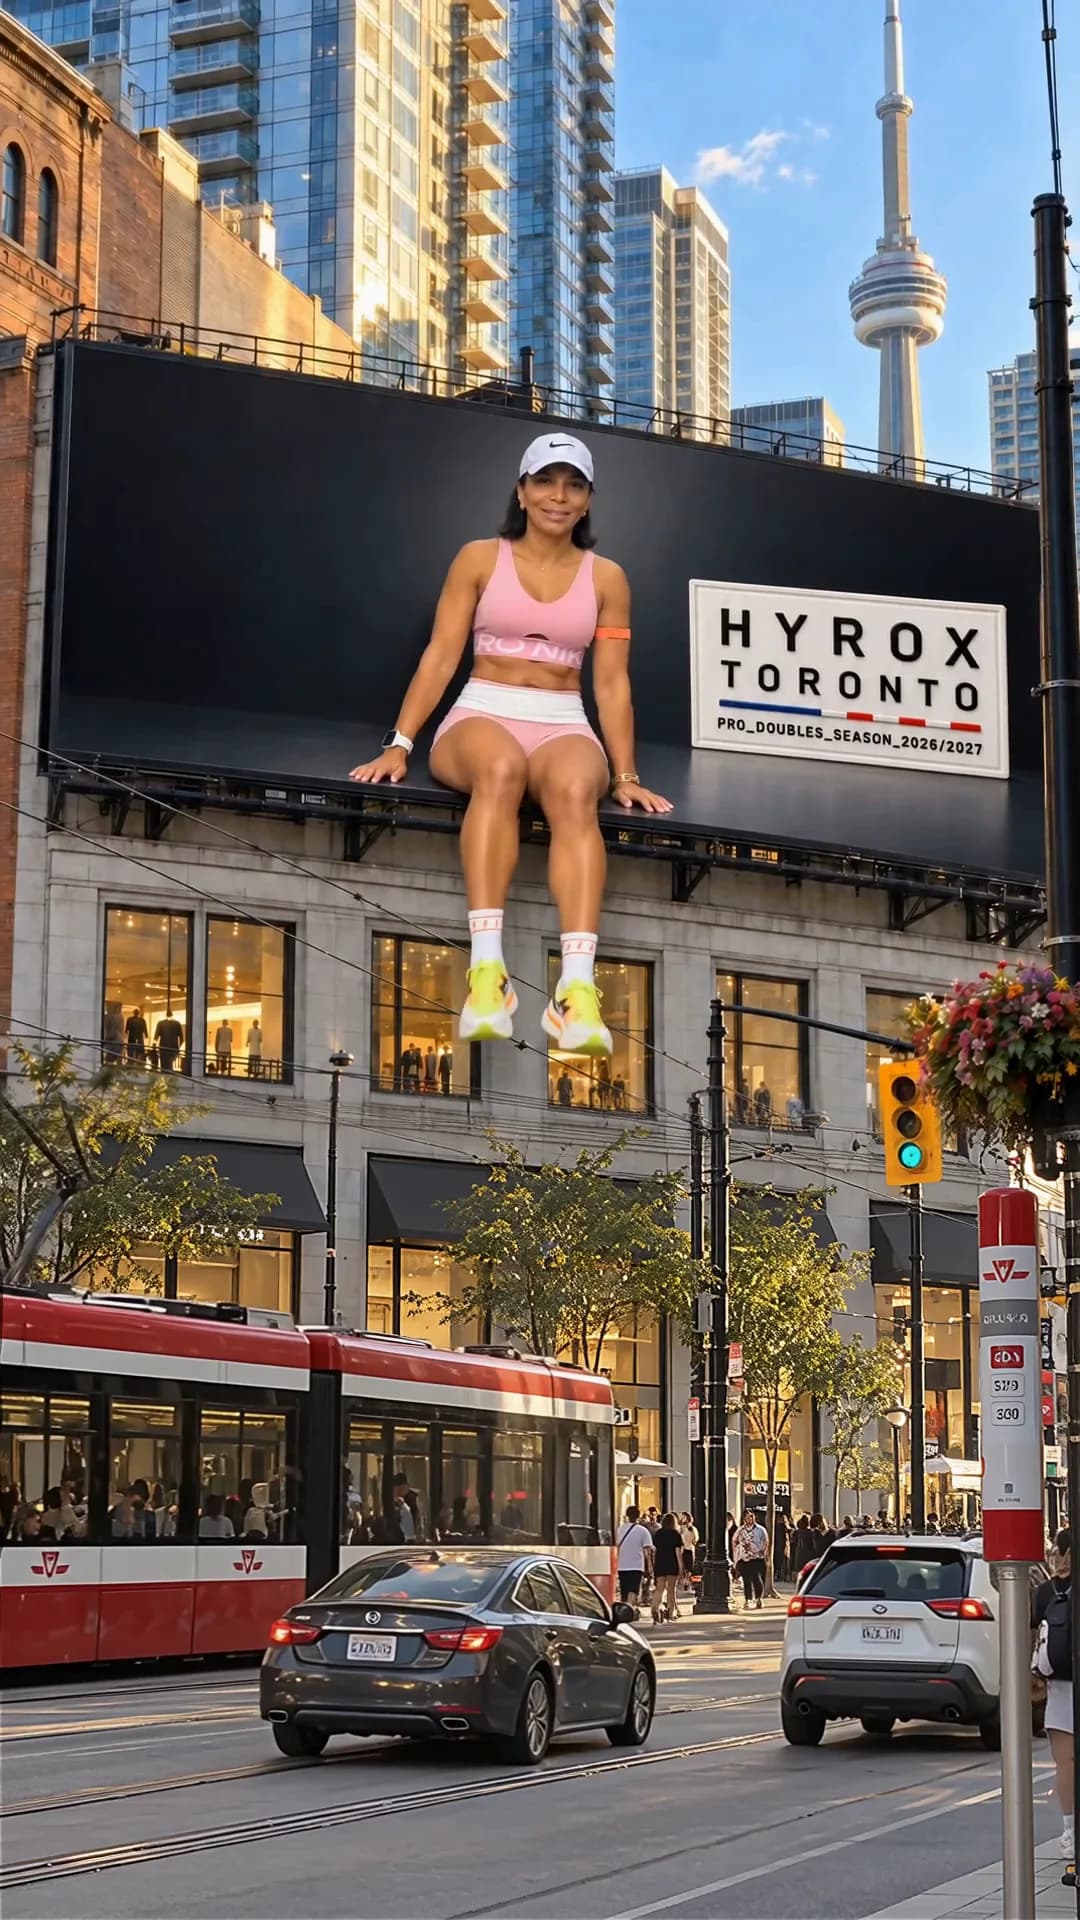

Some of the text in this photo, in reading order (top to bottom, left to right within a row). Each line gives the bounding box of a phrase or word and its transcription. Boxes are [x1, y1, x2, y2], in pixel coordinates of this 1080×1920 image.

[721, 608, 980, 669] HYROX
[721, 660, 978, 711] TORONTO
[718, 717, 982, 755] PRO_DOUBLES_SEASON_2026/2027
